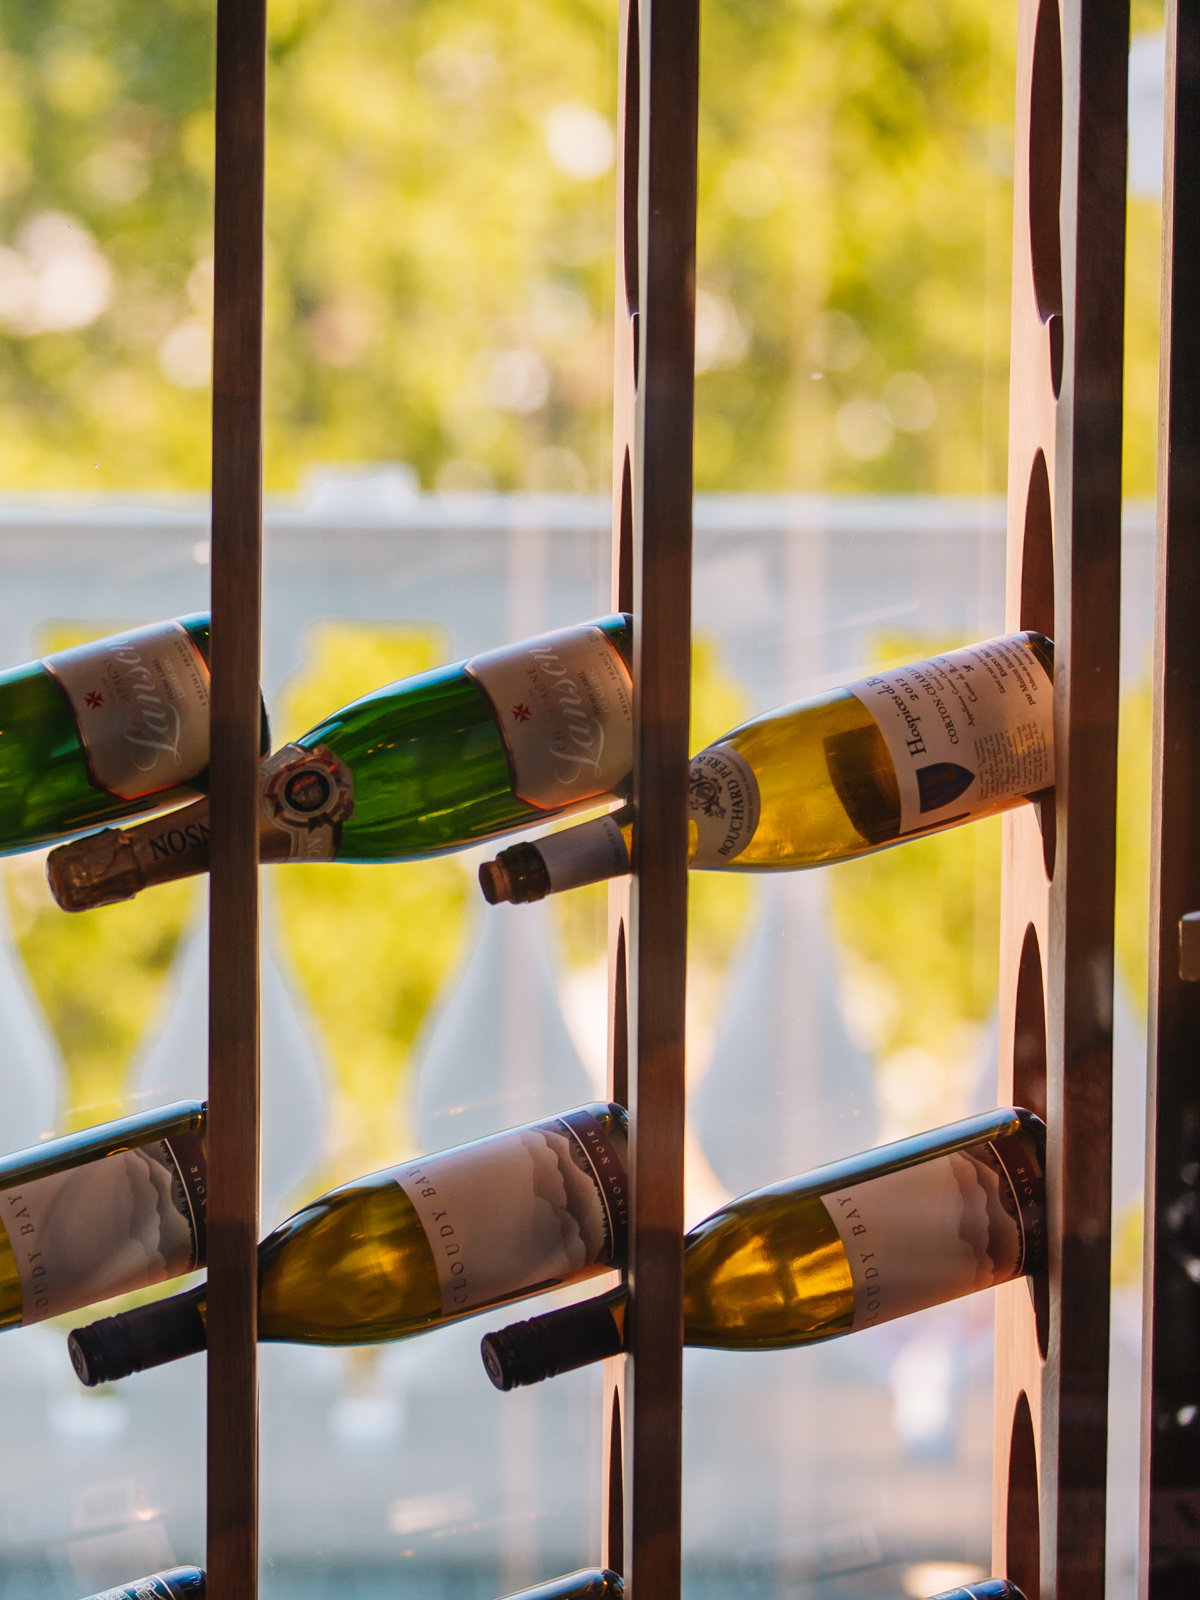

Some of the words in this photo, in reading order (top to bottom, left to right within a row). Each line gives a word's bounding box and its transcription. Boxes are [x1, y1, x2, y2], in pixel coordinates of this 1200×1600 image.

[877, 684, 896, 695] de
[895, 678, 919, 701] 2012
[529, 645, 605, 784] Lanson
[891, 695, 927, 758] Hospices
[705, 757, 733, 780] PÈRE
[717, 780, 744, 856] BOUCHARD
[587, 1131, 611, 1165] NOIR
[406, 1169, 437, 1198] BAY
[1017, 1167, 1036, 1208] NOIR
[7, 1194, 35, 1237] BAY
[837, 1196, 867, 1237] BAY
[432, 1210, 467, 1304] CLOUDY
[859, 1252, 881, 1322] LOUDY
